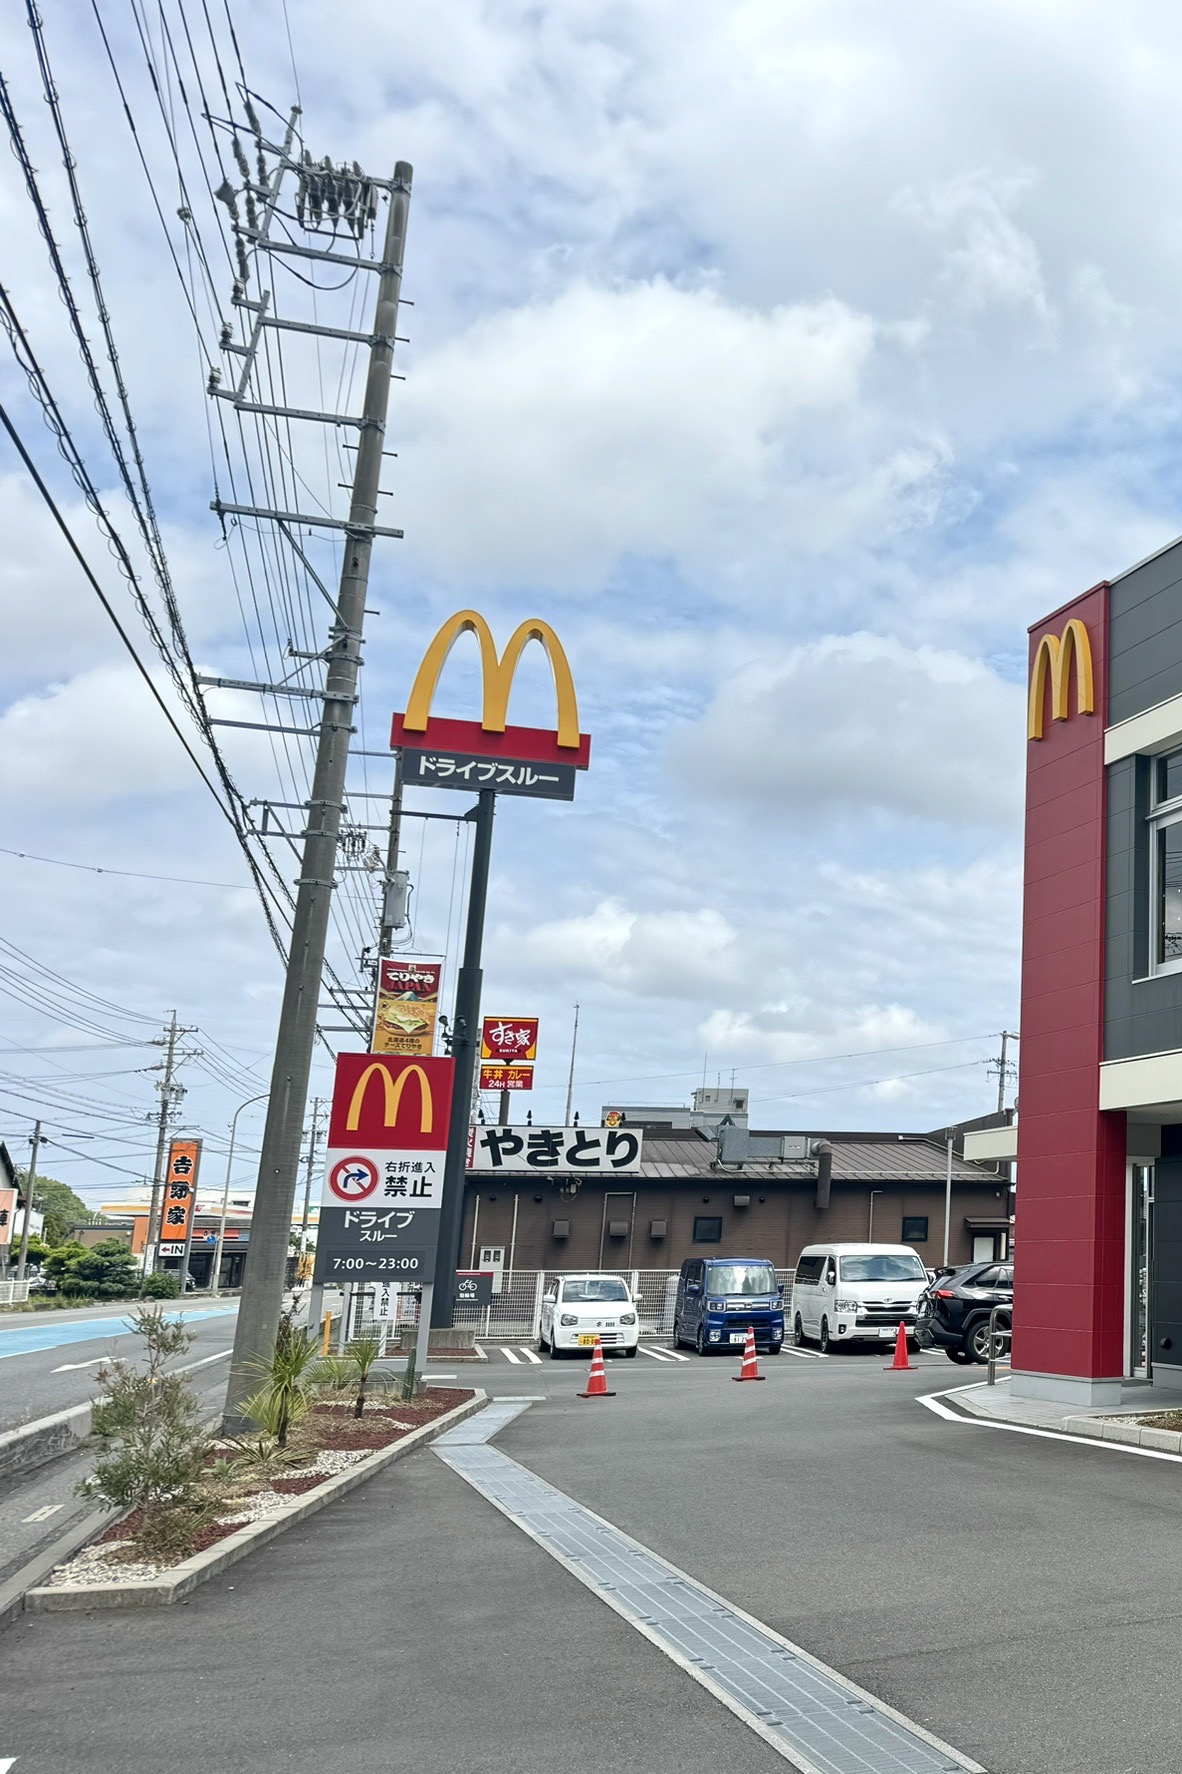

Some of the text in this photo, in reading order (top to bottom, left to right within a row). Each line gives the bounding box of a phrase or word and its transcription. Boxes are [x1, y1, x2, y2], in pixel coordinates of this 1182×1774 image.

[419, 755, 559, 786] ドライブスルー
[386, 972, 435, 984] てりやき
[489, 1021, 531, 1049] すき家
[483, 1069, 531, 1080] 牛丼 カレー
[480, 1128, 638, 1168] やきとり
[385, 1161, 436, 1173] 右折進入
[384, 1175, 432, 1198] 禁止
[344, 1210, 415, 1228] ドライブ
[359, 1230, 398, 1242] スルー
[171, 1245, 183, 1254] IN
